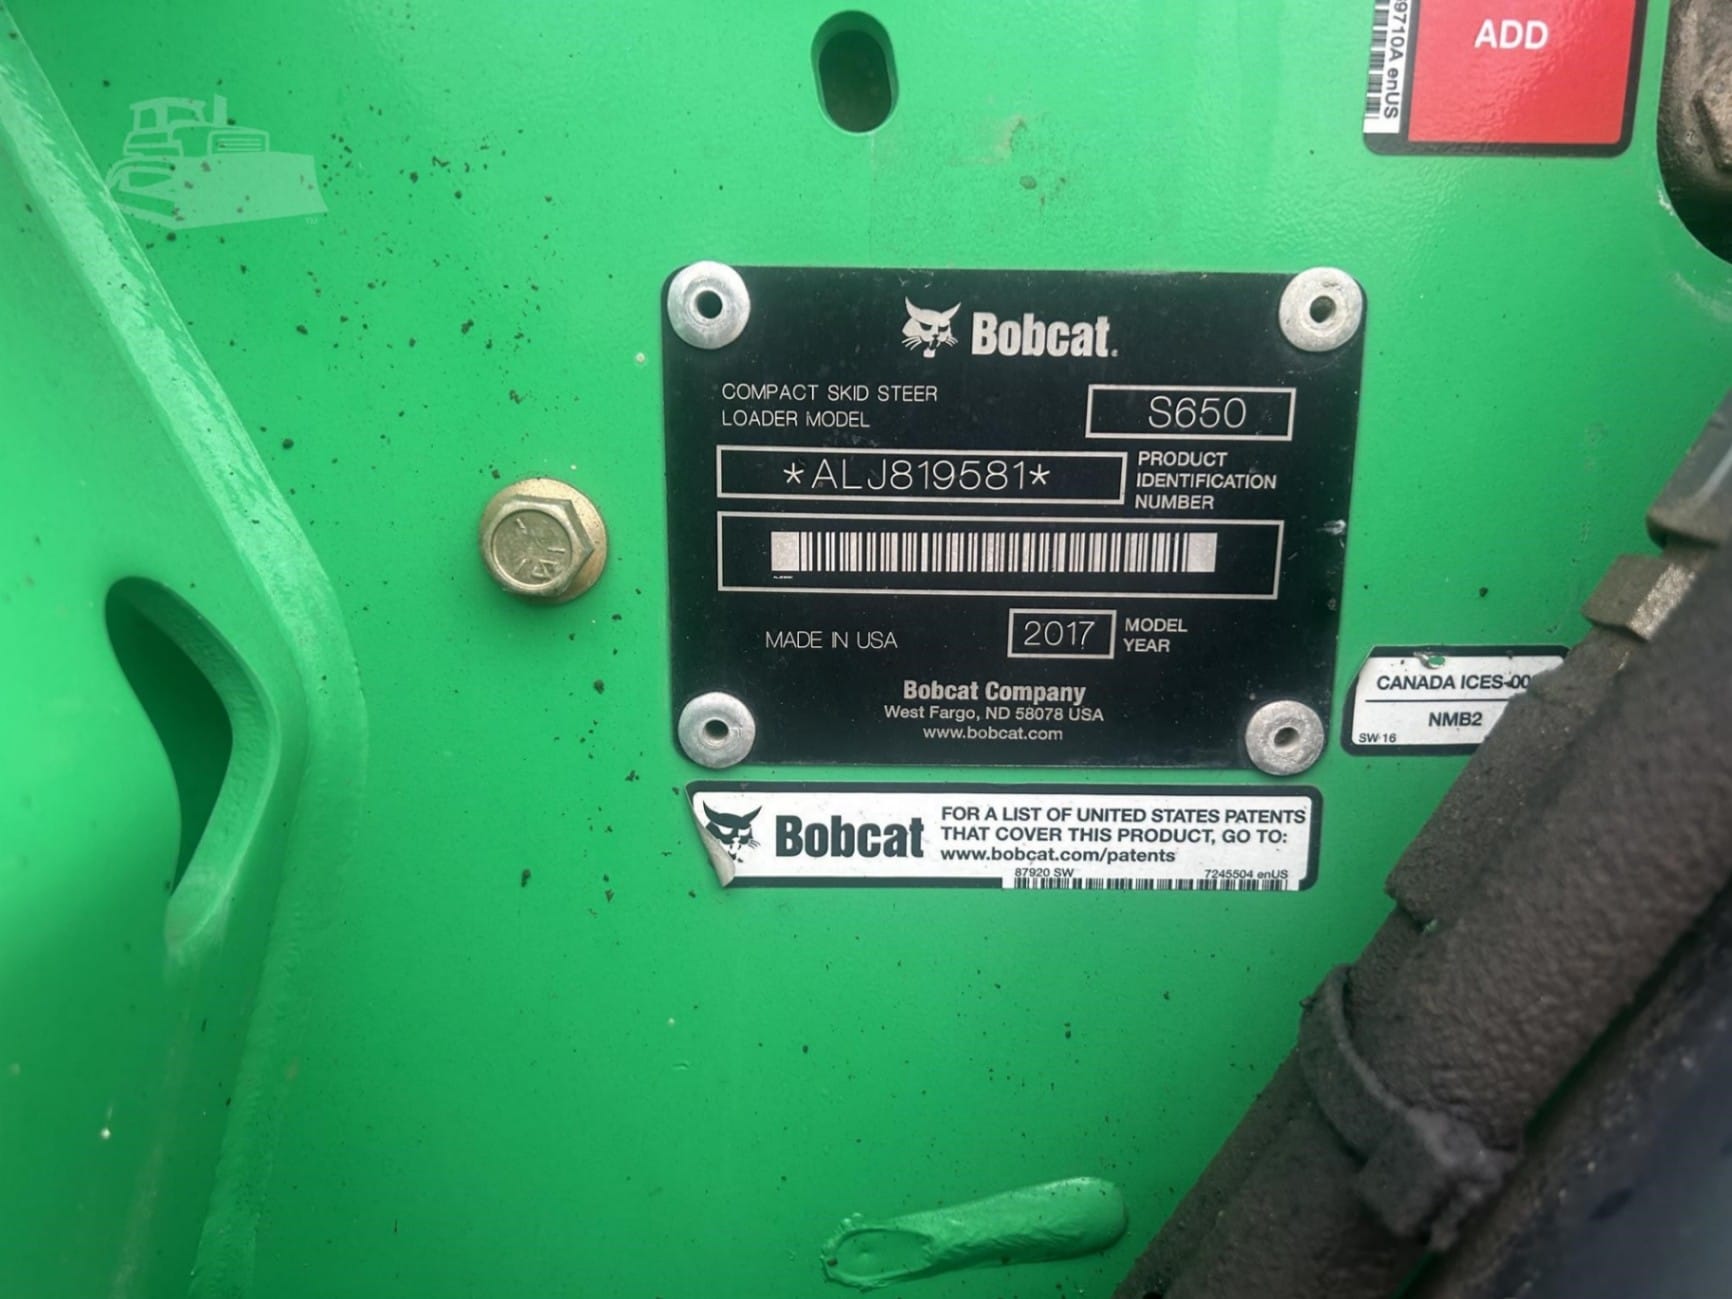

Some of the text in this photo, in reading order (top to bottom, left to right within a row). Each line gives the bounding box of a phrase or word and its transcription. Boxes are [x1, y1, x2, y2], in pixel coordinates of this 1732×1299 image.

[1474, 18, 1549, 50] ADD
[1384, 0, 1408, 119] 9710A enUS
[721, 383, 938, 402] COMPACT SKID STEER
[721, 409, 870, 427] LOADER MODEL
[1148, 395, 1247, 429] S650
[1137, 451, 1228, 467] PRODUCT
[1136, 473, 1277, 489] IDENTIFICATION
[1134, 494, 1215, 510] NUMBER
[1023, 620, 1096, 647] 2017
[1124, 618, 1188, 633] MODEL
[765, 630, 898, 650] MADE IN USA
[1123, 638, 1171, 653] YEAR
[1376, 674, 1532, 691] CANADA ICES-00
[903, 679, 1086, 706] Bobcat Company
[884, 705, 1105, 723] West Fargo, ND 58078 USA
[1428, 711, 1483, 728] NMB2
[923, 725, 1064, 742] www.bobcat.com
[941, 806, 1306, 826] FOR A LIST OF UNITED STATES PATENTS
[775, 814, 925, 859] Bobcat
[941, 826, 1289, 846] THAT COVER THIS PRODUCT, GO TO:
[940, 846, 1176, 864] www.bobcat.com/patents
[1014, 868, 1076, 879] 87920 SW
[1204, 869, 1290, 880] 7245504 enUS
